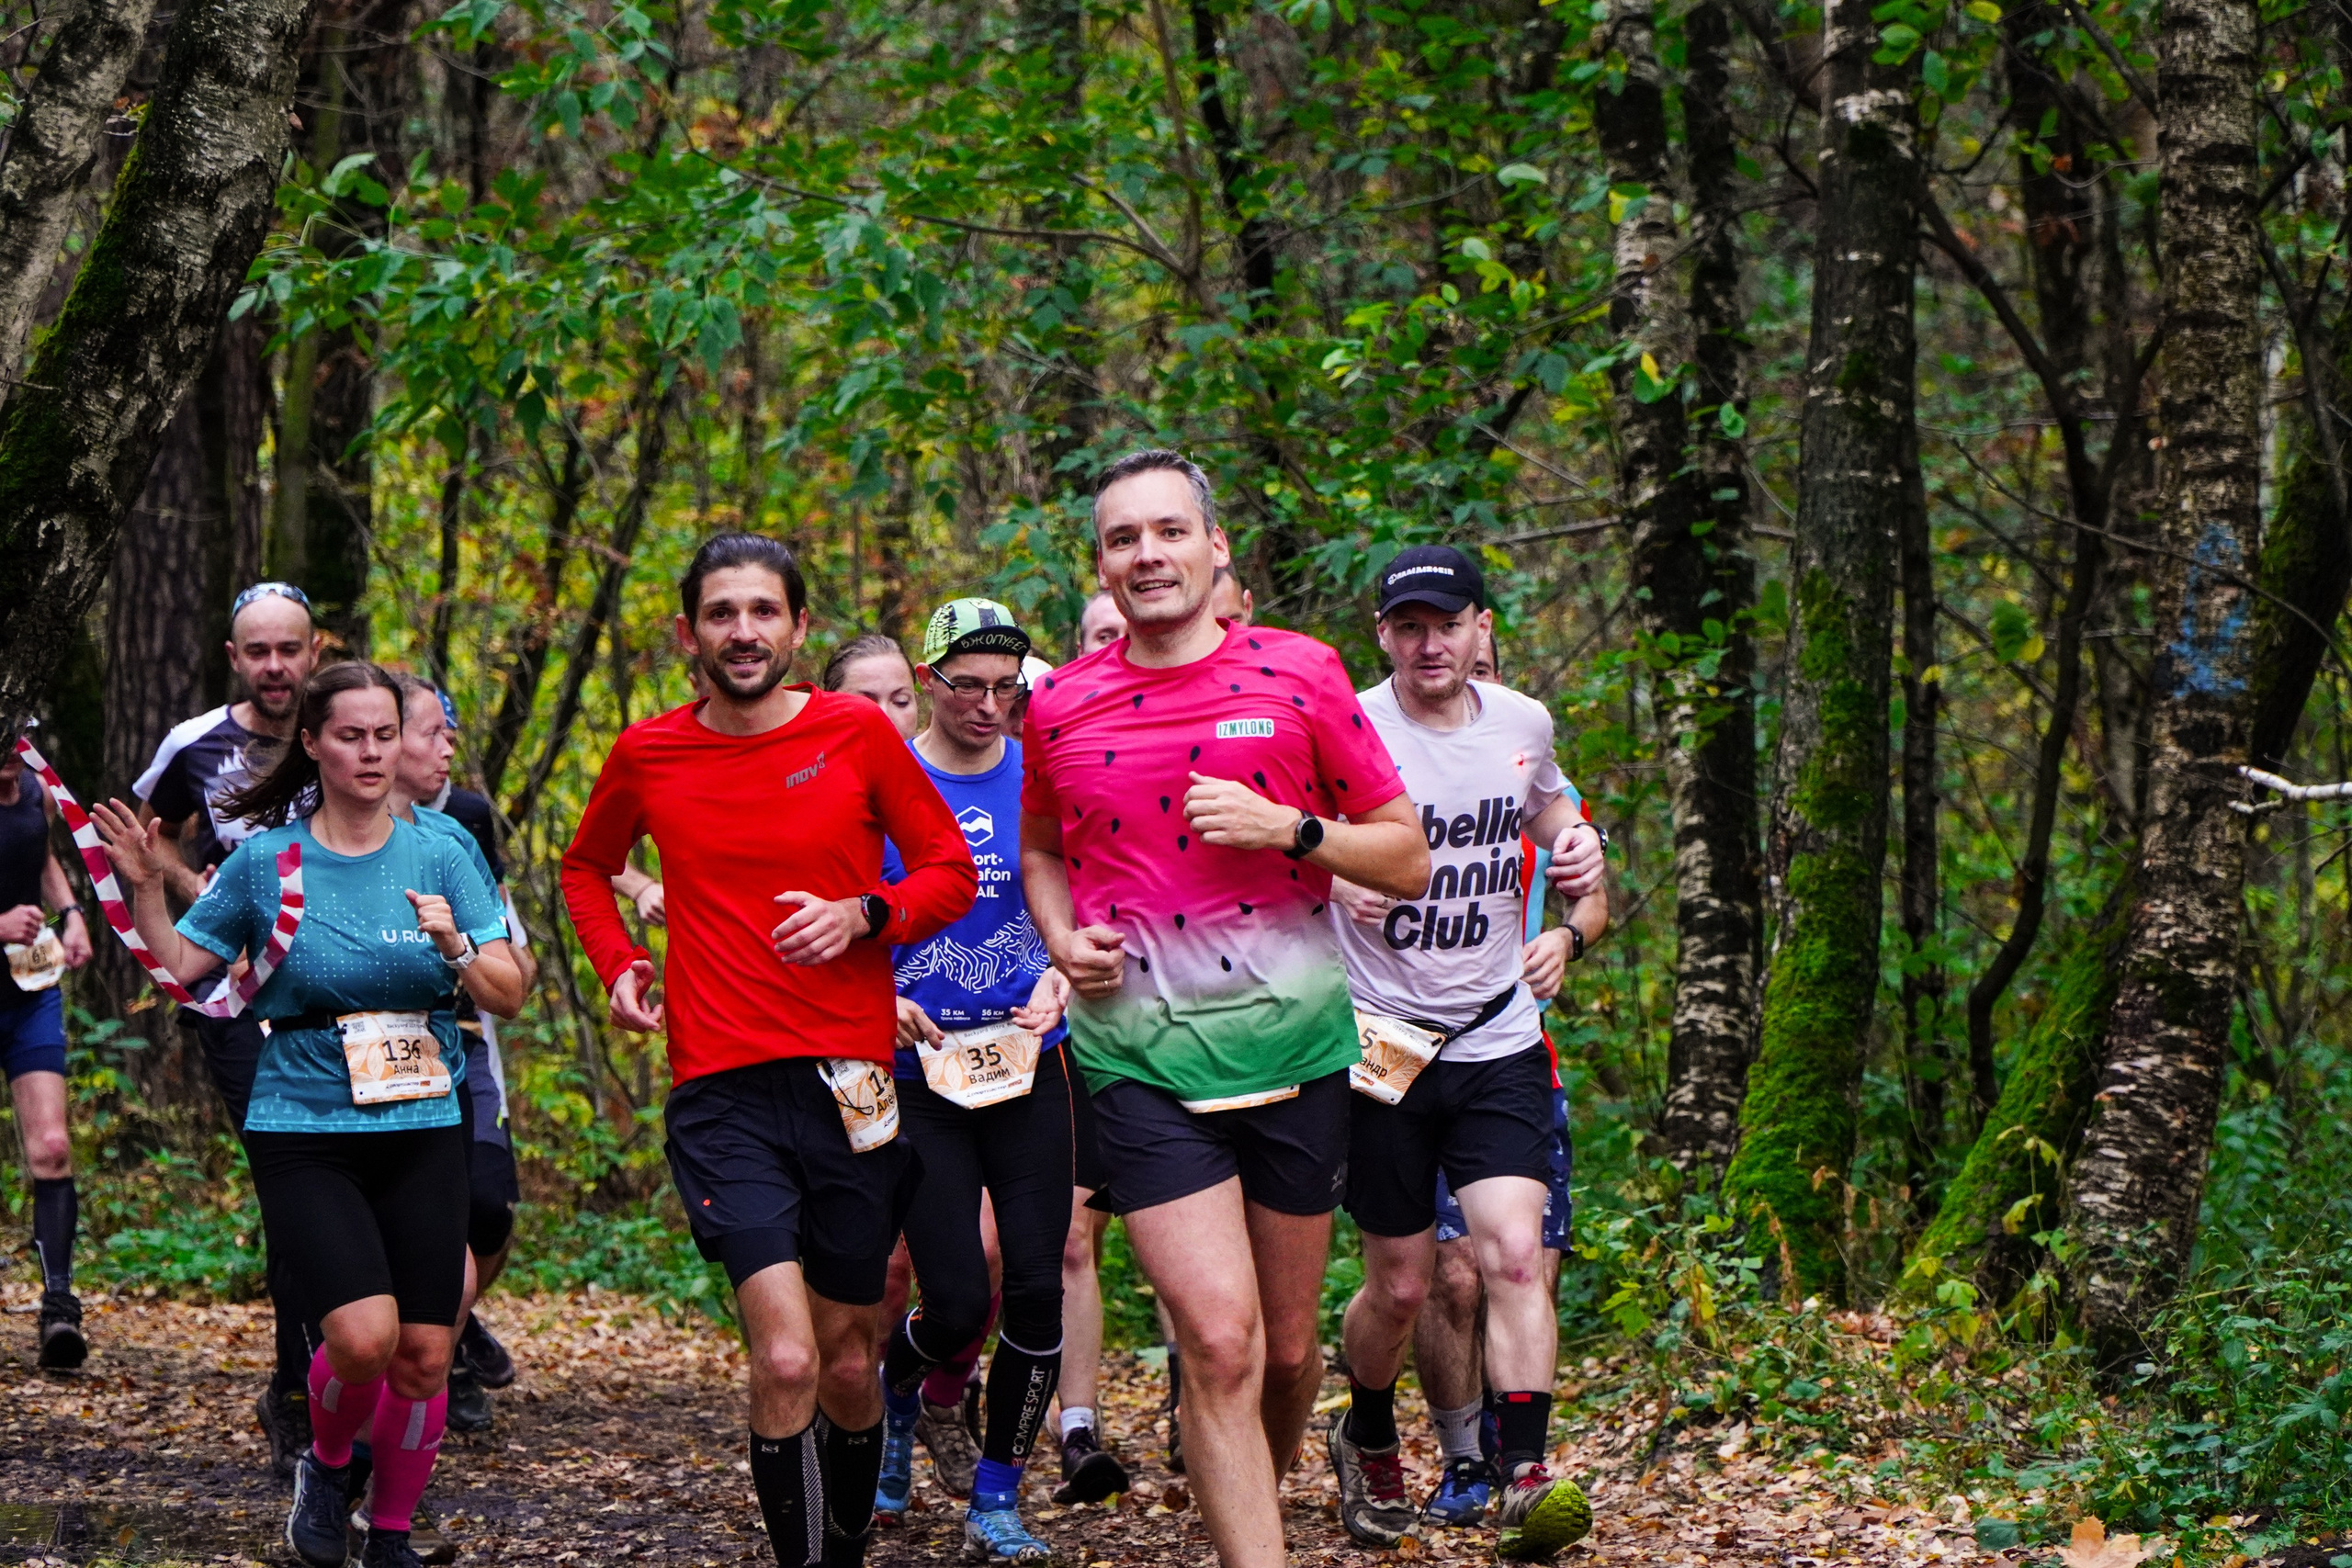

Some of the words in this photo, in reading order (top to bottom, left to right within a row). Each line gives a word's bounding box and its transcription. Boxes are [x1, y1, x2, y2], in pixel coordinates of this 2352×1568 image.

[1218, 720, 1272, 737] IZMYLONG
[977, 867, 1012, 882] afon
[975, 885, 1000, 898] AIL
[1384, 902, 1489, 952] Club
[381, 1039, 422, 1062] 136
[967, 1043, 1002, 1071] 35
[393, 1064, 420, 1075] Анна
[968, 1067, 1011, 1085] Вадим
[1360, 1056, 1388, 1078] андр
